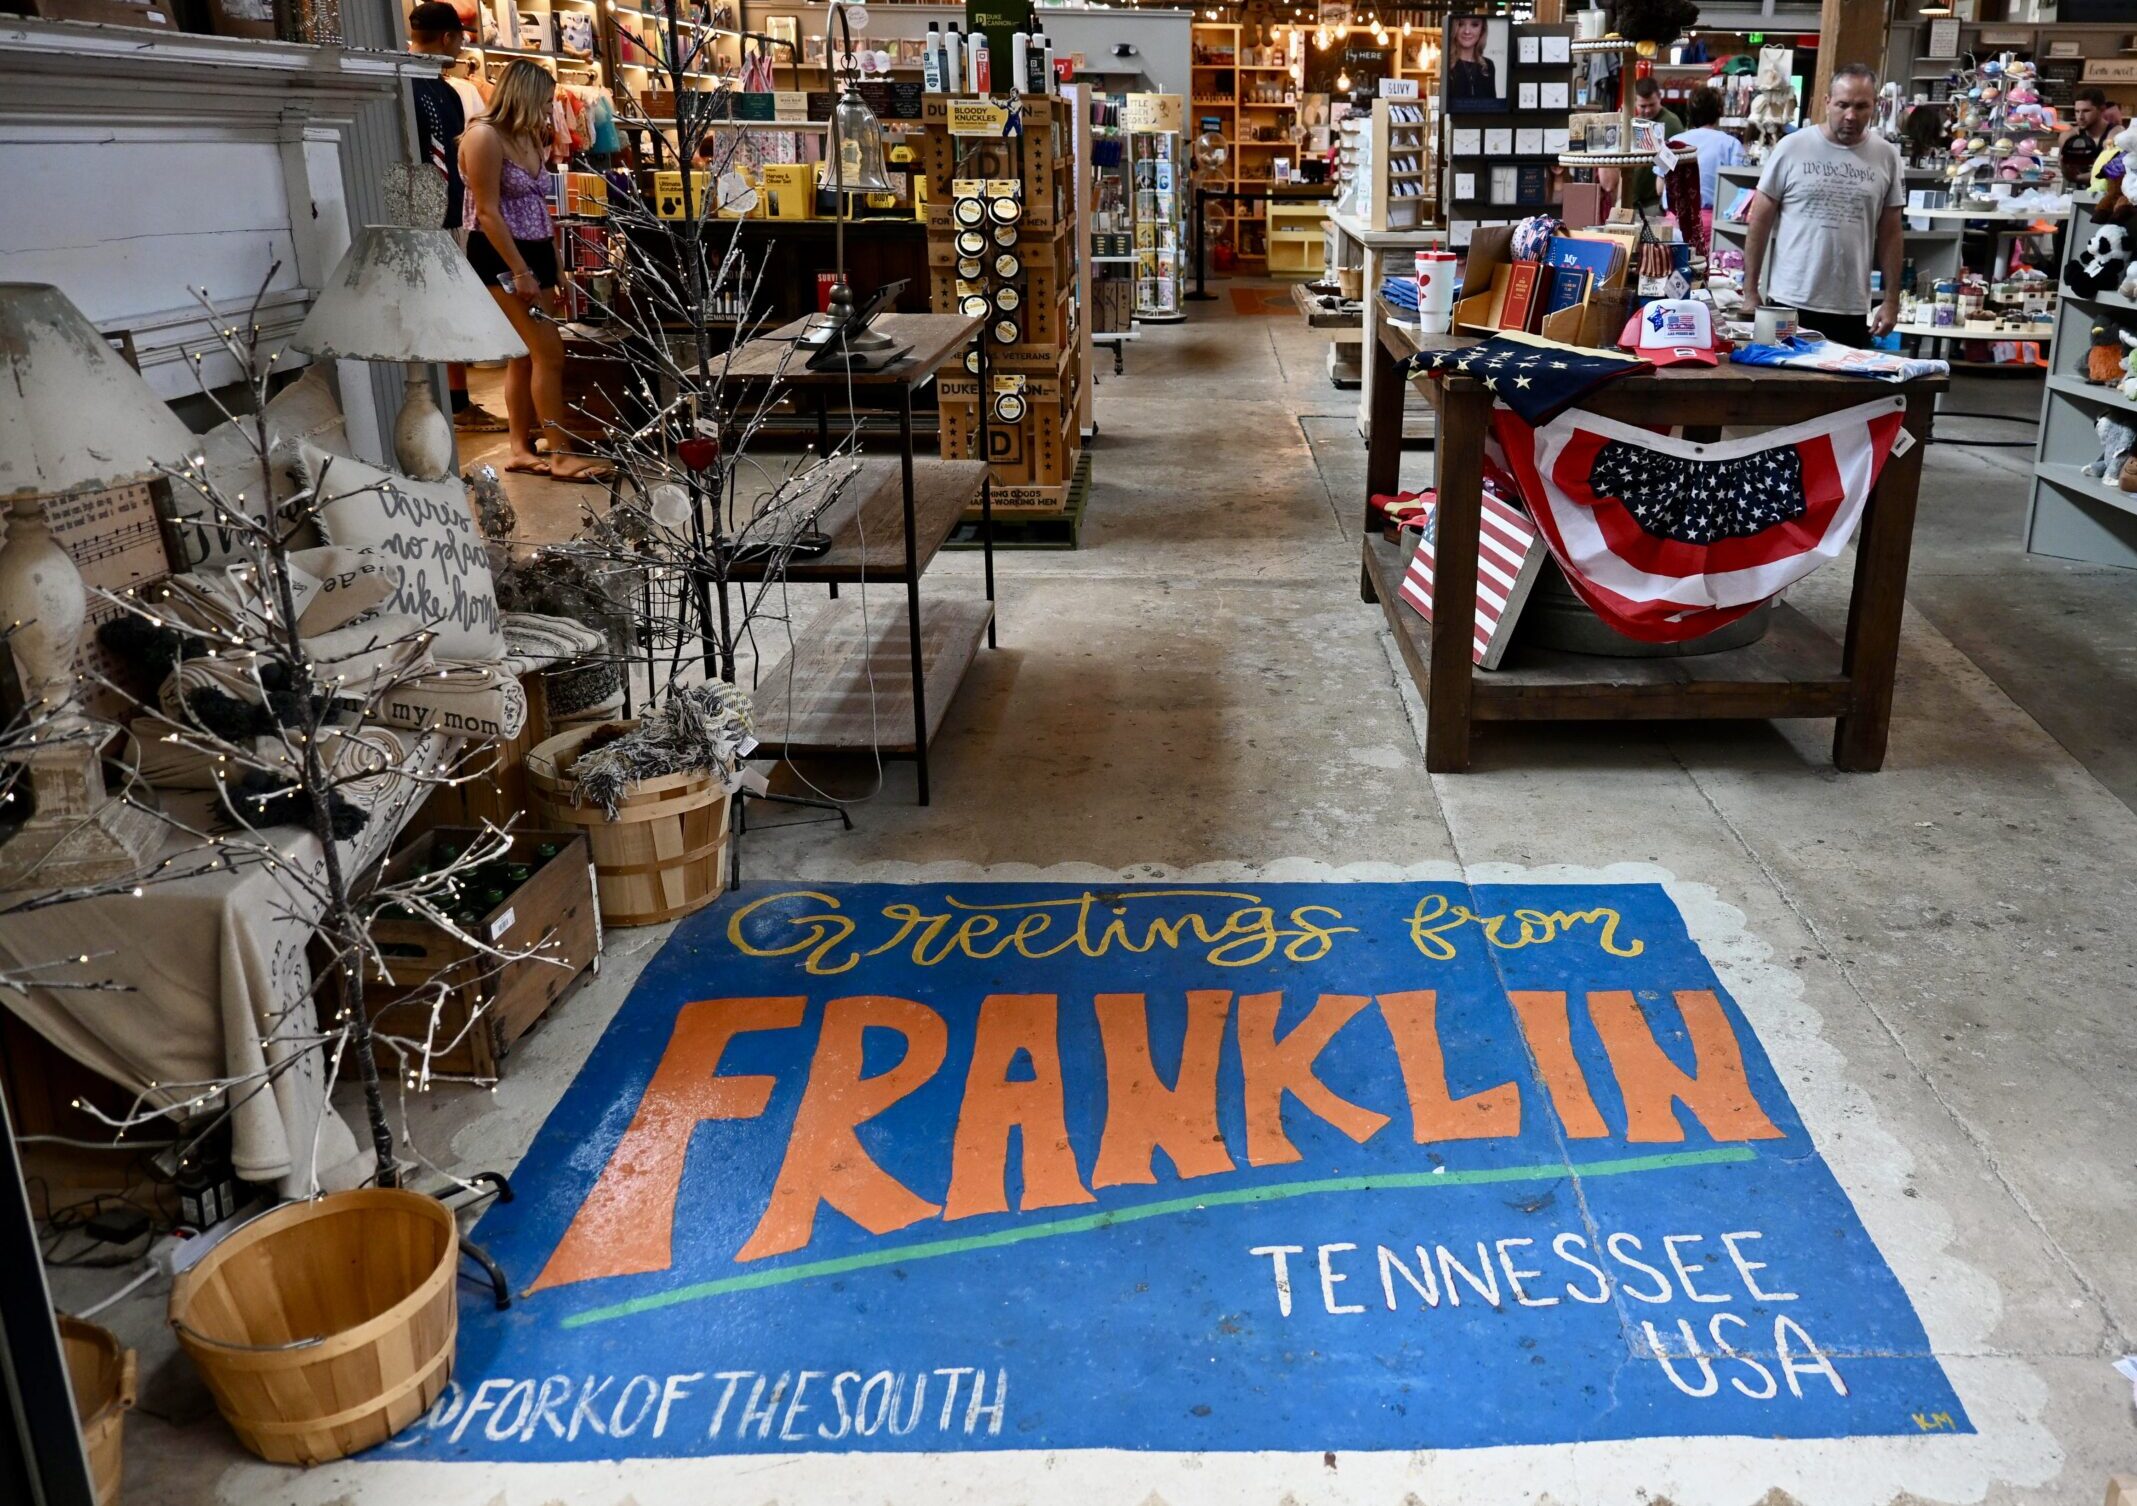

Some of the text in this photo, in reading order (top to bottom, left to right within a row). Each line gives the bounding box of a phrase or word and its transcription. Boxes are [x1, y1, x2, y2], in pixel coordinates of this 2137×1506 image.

[1360, 52, 1382, 60] HERE
[1803, 161, 1875, 182] We the People
[874, 193, 889, 201] BODY
[1564, 254, 1577, 265] My
[818, 273, 847, 281] SURVIE
[1003, 352, 1050, 360] VETERANS
[941, 383, 978, 395] DUKE
[1038, 498, 1057, 506] MEN
[381, 533, 428, 559] no
[387, 565, 447, 624] like
[392, 702, 429, 726] my
[444, 712, 500, 735] mom
[727, 891, 1644, 976] Greetings from
[521, 989, 1788, 1297] FRANKLIN
[1250, 1231, 1799, 1317] TENNESSEE
[1642, 1313, 1849, 1400] USA
[1912, 1410, 1957, 1432] KM
